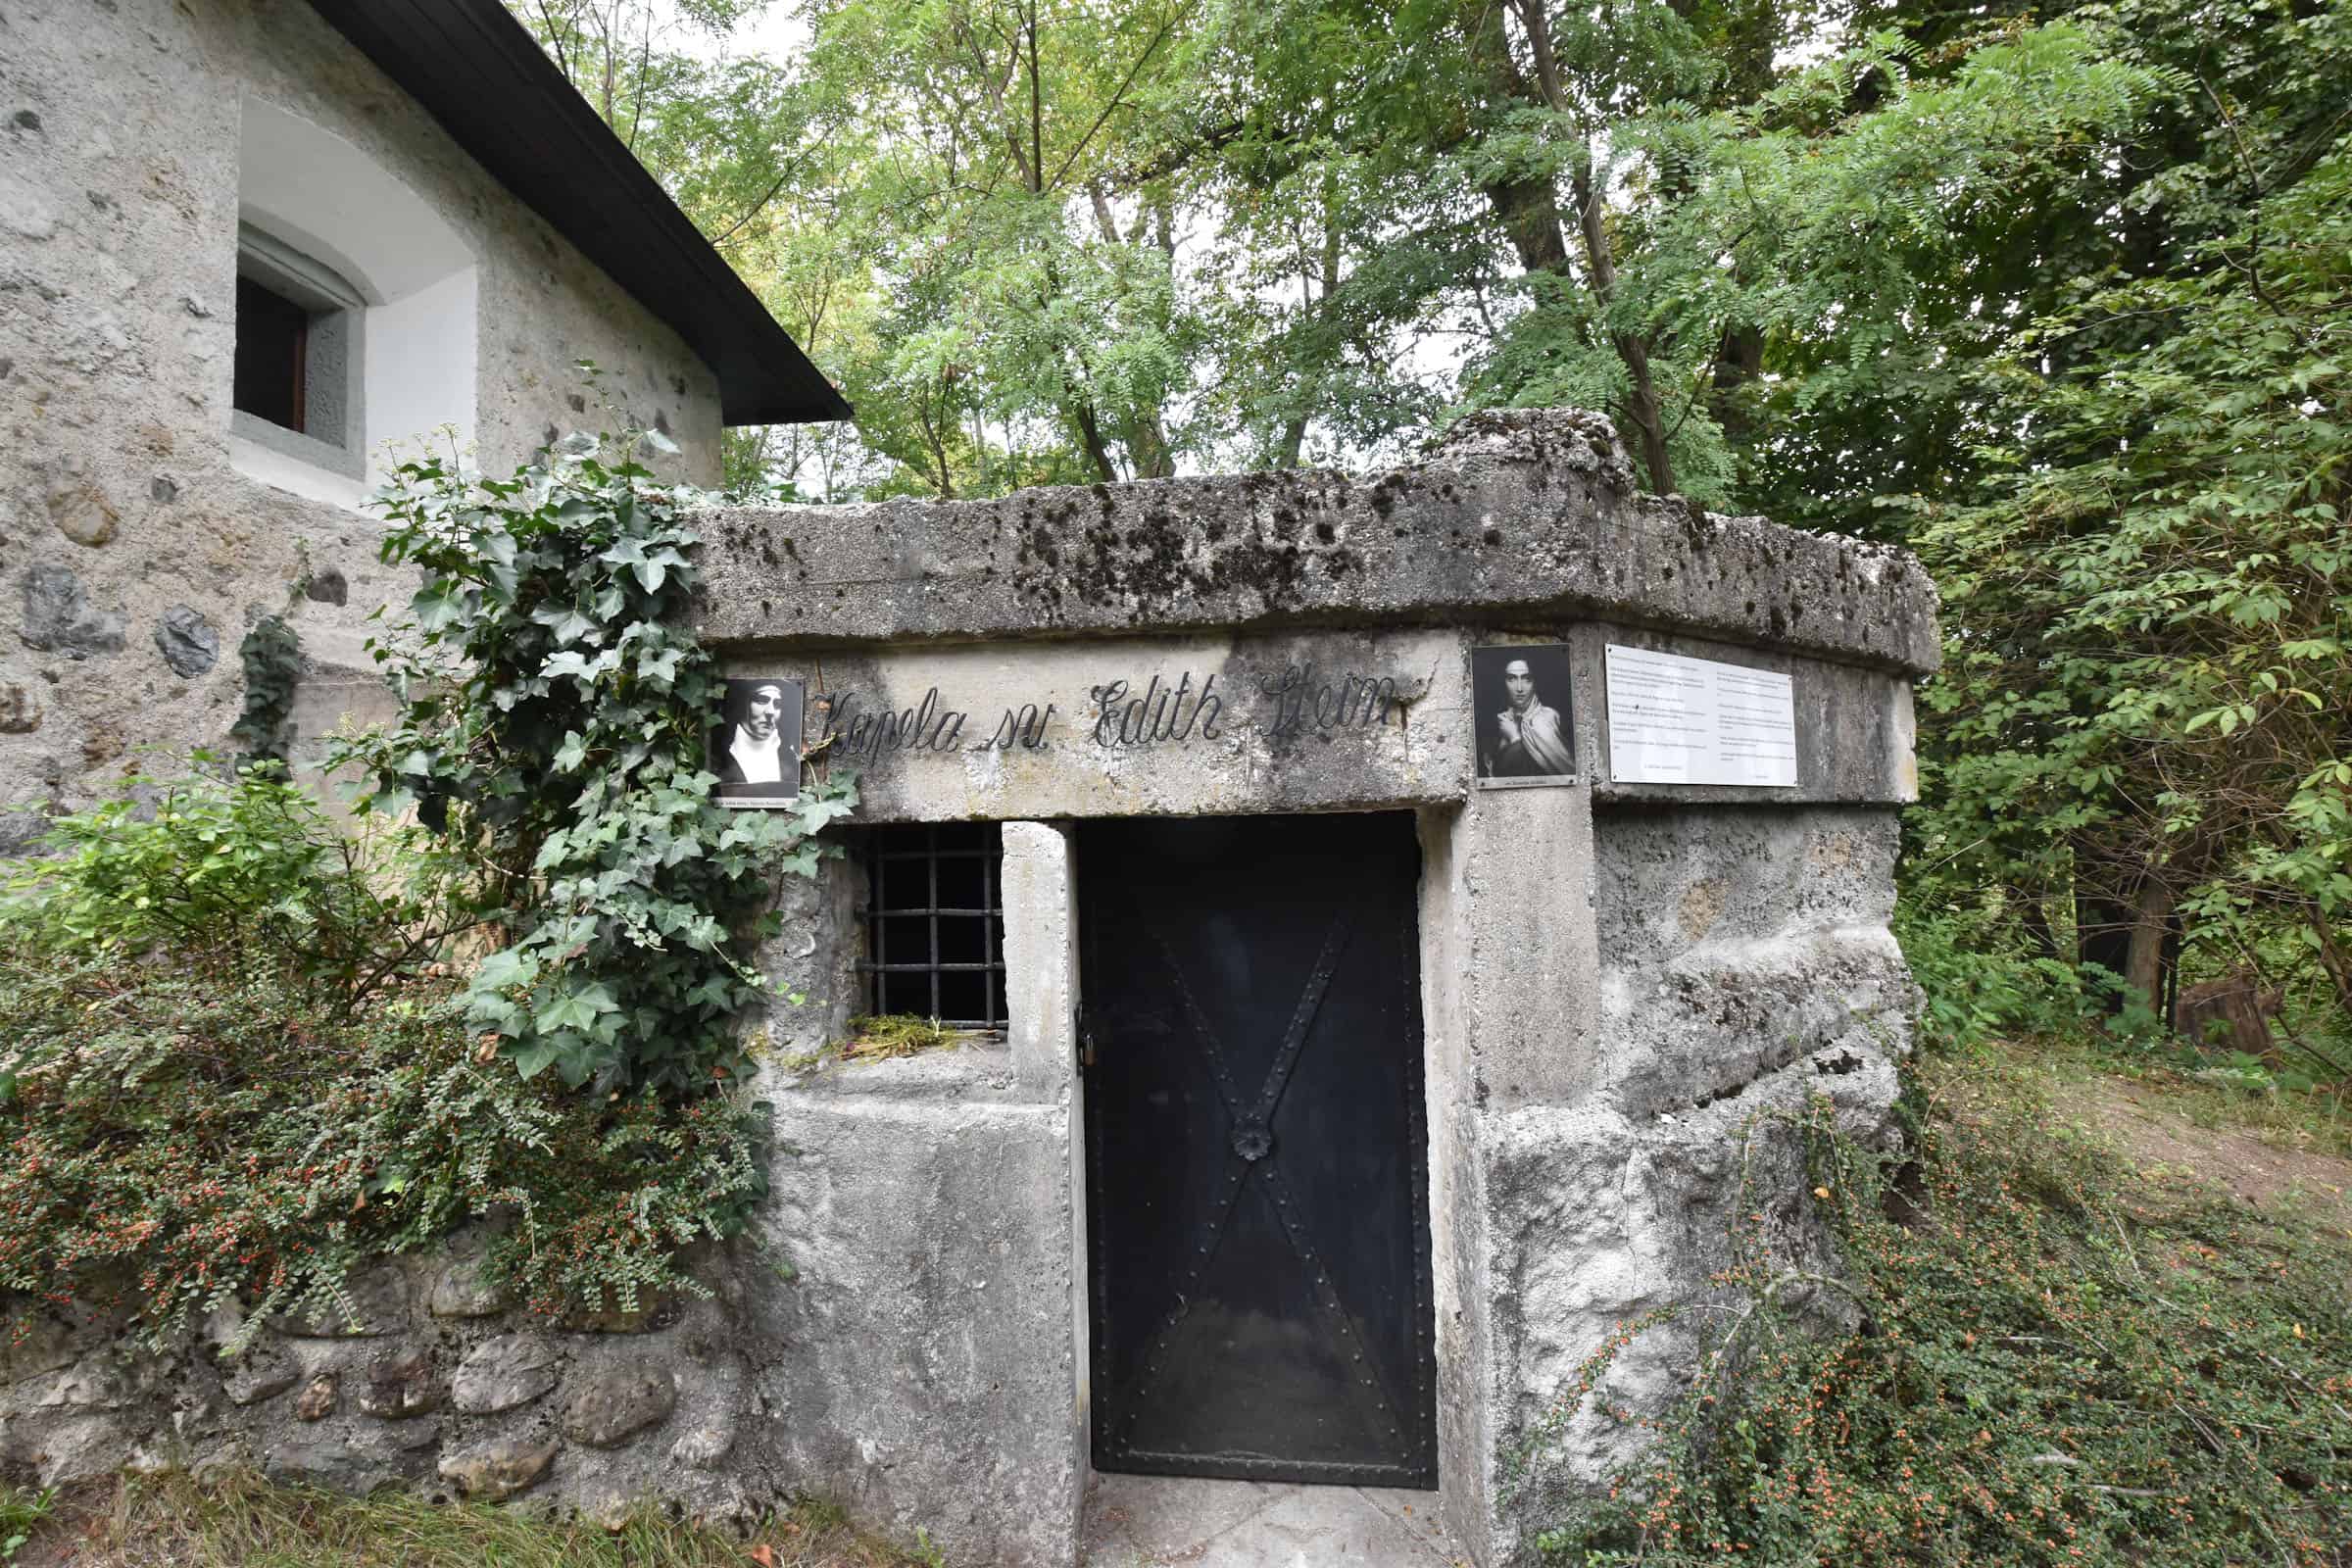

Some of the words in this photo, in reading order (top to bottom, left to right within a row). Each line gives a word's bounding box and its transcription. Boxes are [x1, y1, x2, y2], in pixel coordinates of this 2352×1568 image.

[819, 686, 968, 769] Kapela
[1091, 671, 1222, 748] Edith
[1260, 662, 1396, 736] Stein
